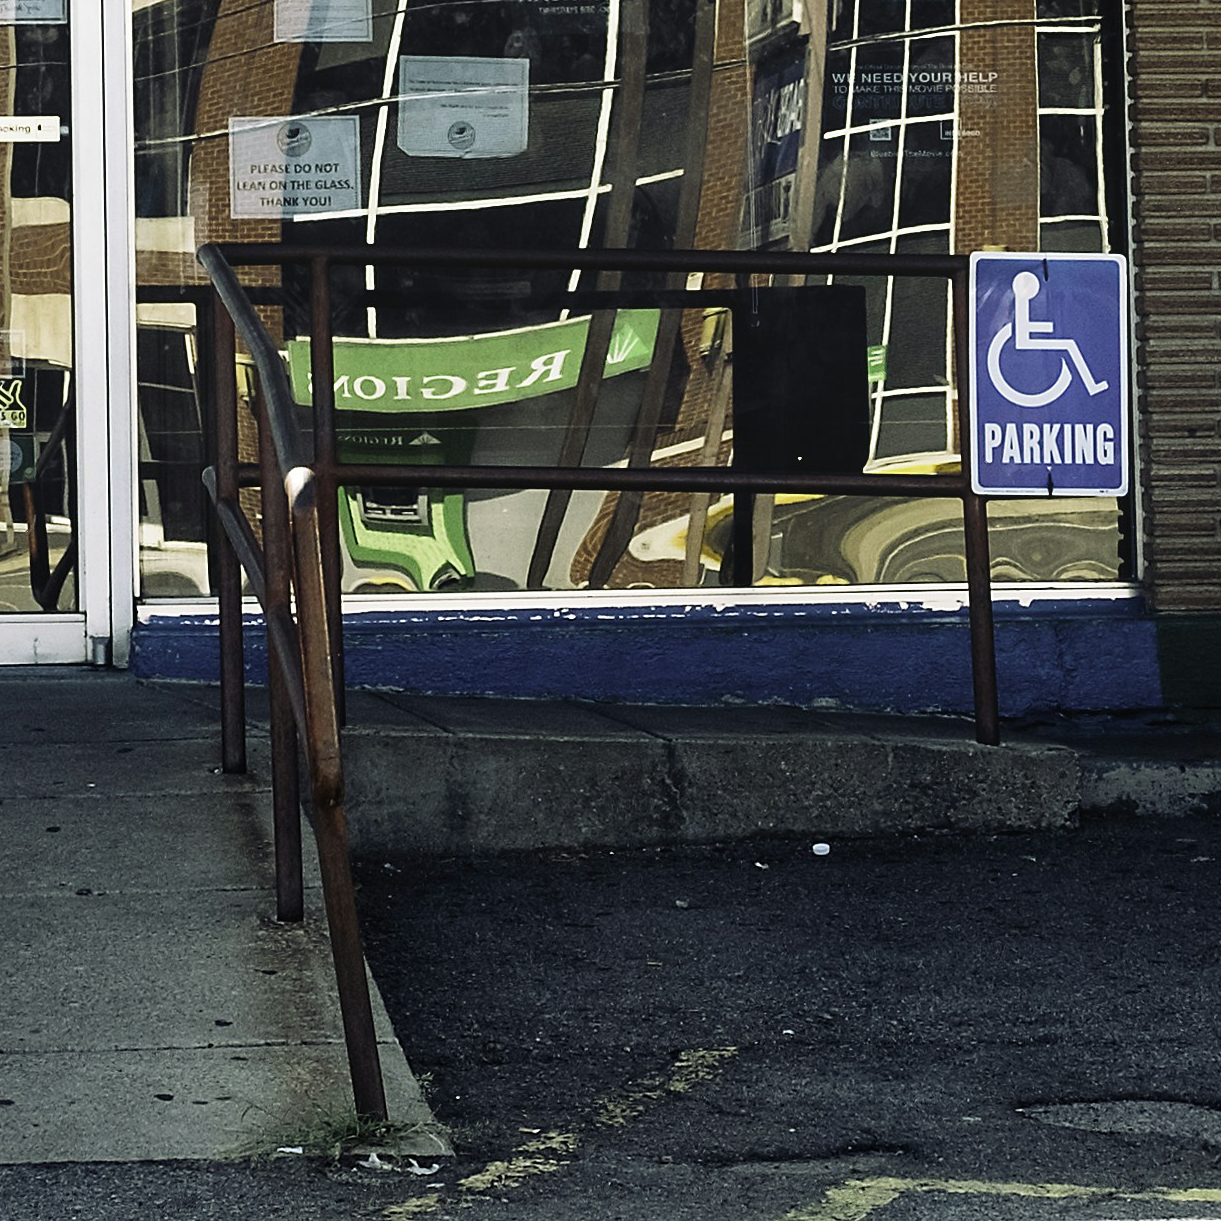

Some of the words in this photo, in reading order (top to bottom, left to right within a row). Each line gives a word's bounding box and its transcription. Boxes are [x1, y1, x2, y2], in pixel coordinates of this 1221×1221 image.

[862, 72, 903, 83] NEED
[909, 72, 953, 83] YOUR
[834, 86, 847, 94] TO
[909, 84, 943, 93] MOVIE
[250, 163, 291, 174] PLEASE
[294, 163, 311, 173] DO
[315, 163, 340, 173] NOT
[237, 180, 266, 191] LEAN
[269, 180, 287, 191] ON
[290, 180, 311, 190] THE
[315, 179, 354, 190] GLASS.
[260, 197, 299, 207] THANK
[301, 196, 332, 207] YOU!
[10, 411, 26, 421] GO
[984, 422, 1115, 466] PARKING
